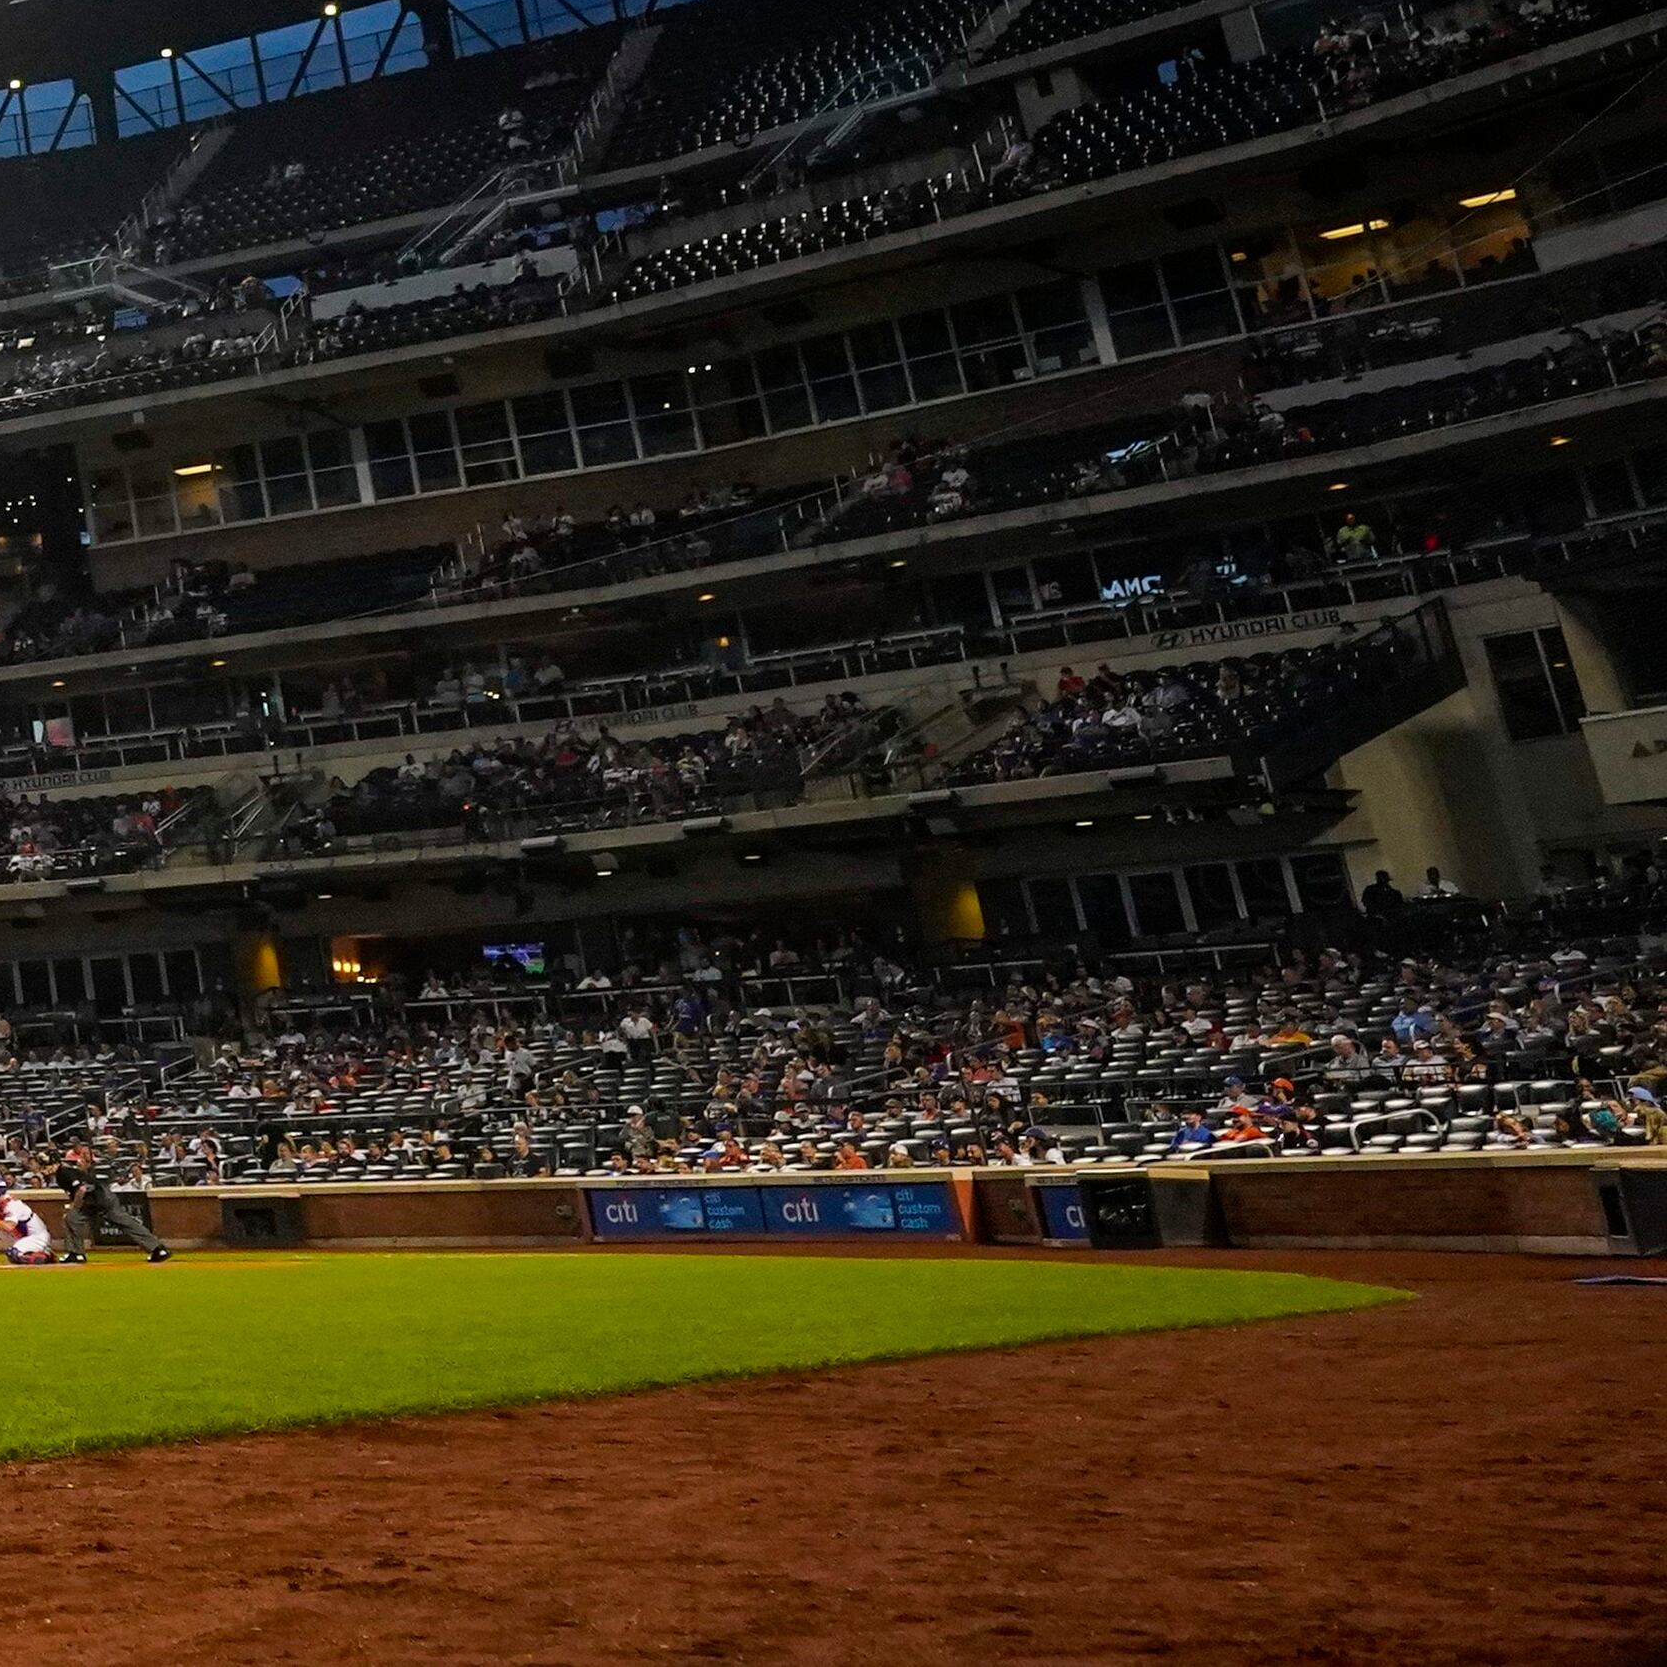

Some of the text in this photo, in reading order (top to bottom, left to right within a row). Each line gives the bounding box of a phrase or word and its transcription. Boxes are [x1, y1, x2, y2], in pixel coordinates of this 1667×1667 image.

[1190, 609, 1341, 643] HYUNDAI CLUB
[606, 1200, 639, 1223] citi
[782, 1197, 819, 1223] citi
